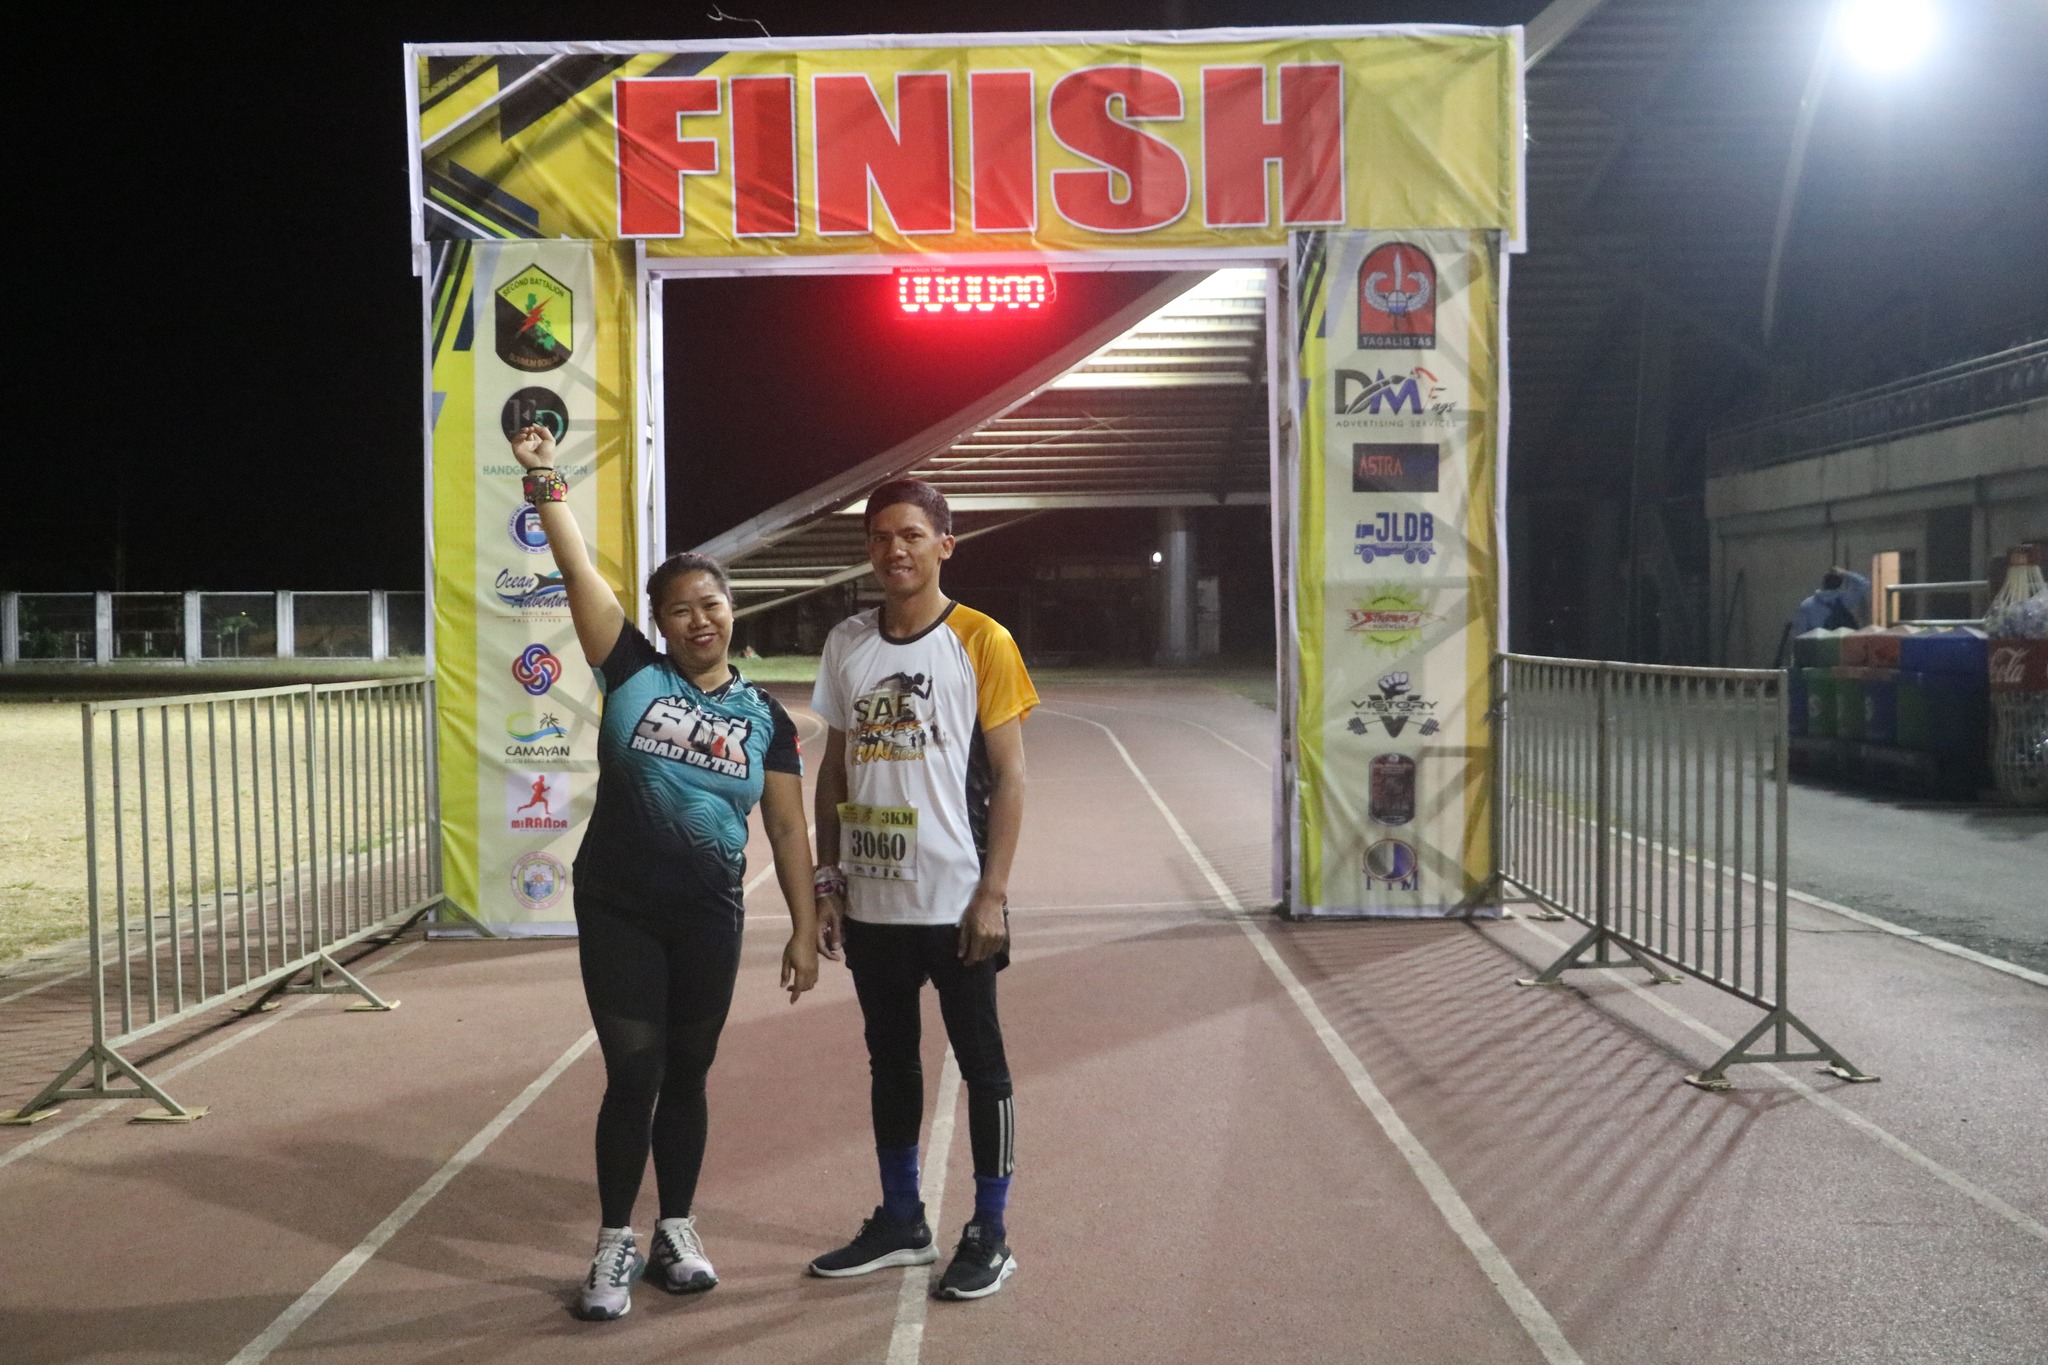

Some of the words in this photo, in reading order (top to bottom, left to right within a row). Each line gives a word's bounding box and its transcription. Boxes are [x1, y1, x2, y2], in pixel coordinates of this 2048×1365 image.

[613, 62, 1345, 239] FINISH
[502, 278, 529, 297] SECOND
[530, 277, 565, 298] BATTALION
[1362, 337, 1432, 347] TAGALIGTAS
[1336, 420, 1404, 428] ADVERTISING
[1410, 420, 1457, 428] SERVICES
[1358, 452, 1403, 477] ASTRA
[1376, 512, 1434, 542] JLDB
[495, 568, 534, 589] Ocean
[511, 590, 570, 609] Adventur
[1350, 700, 1439, 710] VICTORY
[505, 745, 570, 756] CAMAYAN
[630, 735, 682, 761] ROAD
[685, 750, 747, 778] ULTRA
[881, 811, 914, 826] 3KM
[852, 829, 906, 861] 3060
